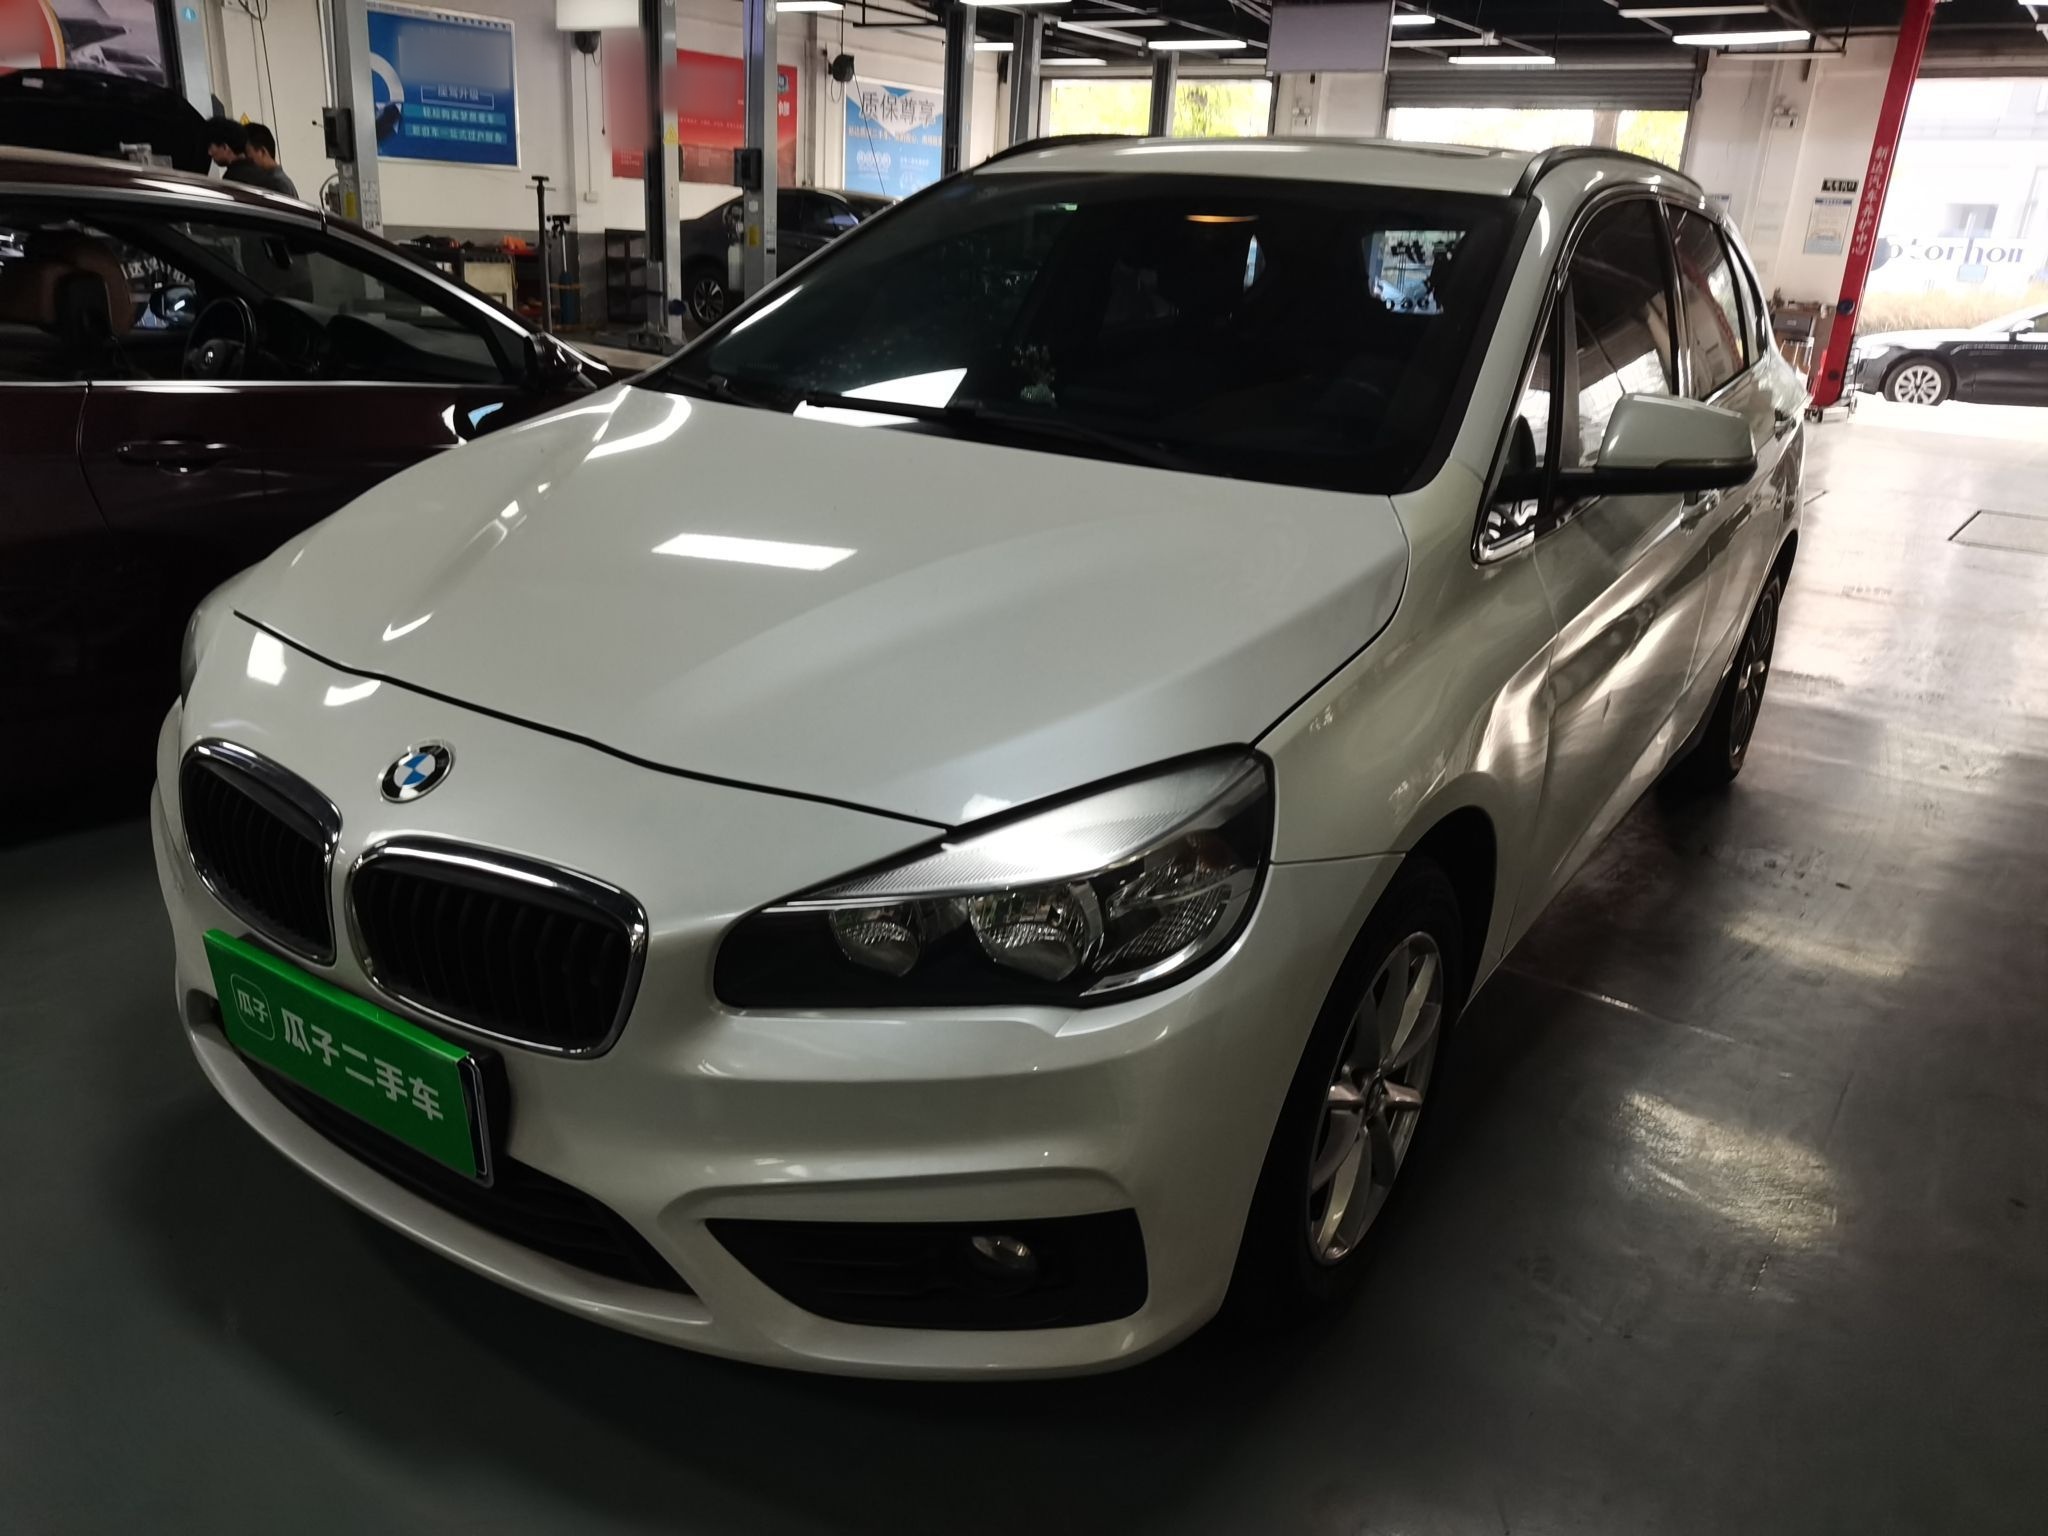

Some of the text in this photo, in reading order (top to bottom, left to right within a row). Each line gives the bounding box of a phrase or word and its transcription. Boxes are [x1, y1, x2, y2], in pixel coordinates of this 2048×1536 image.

[861, 90, 936, 126] 质保尊享
[237, 988, 268, 1023] 瓜子
[281, 1007, 444, 1121] 瓜子二手车
